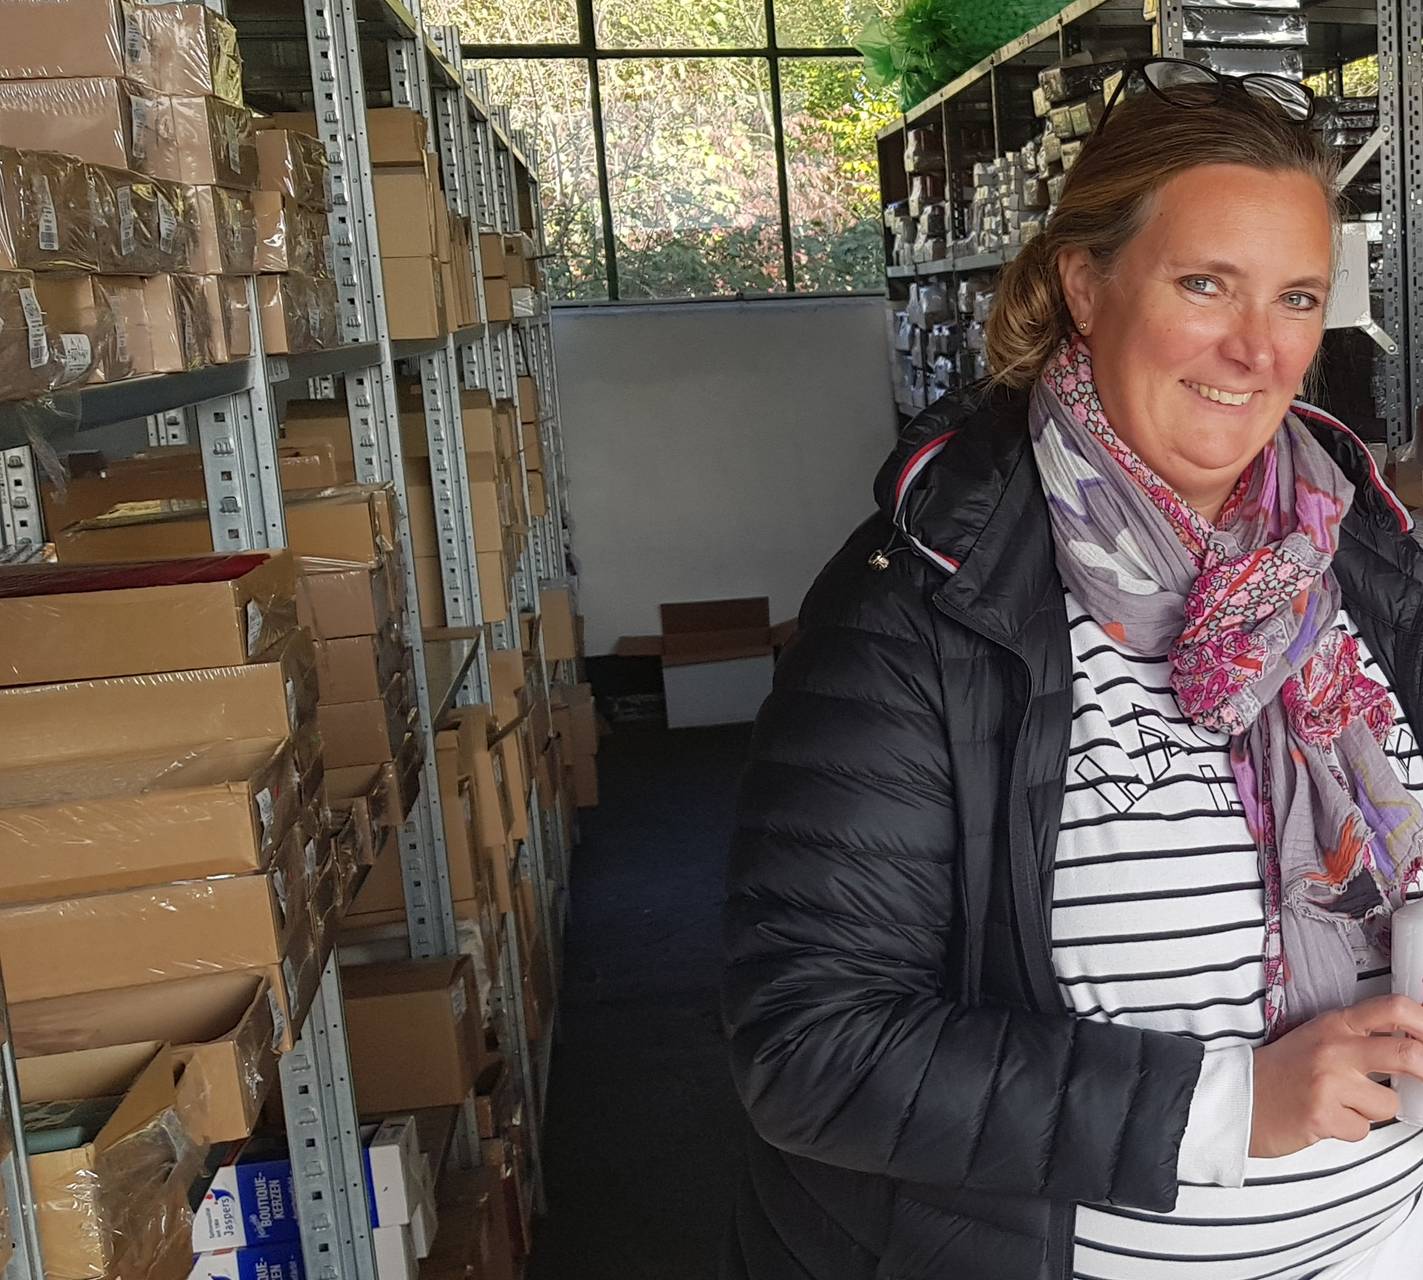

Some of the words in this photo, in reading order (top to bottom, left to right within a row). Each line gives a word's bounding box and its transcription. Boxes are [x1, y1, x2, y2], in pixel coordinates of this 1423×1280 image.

[221, 1198, 235, 1236] Jaspers
[255, 1172, 273, 1228] BOUTIQUE-
[268, 1180, 286, 1220] KERZEN
